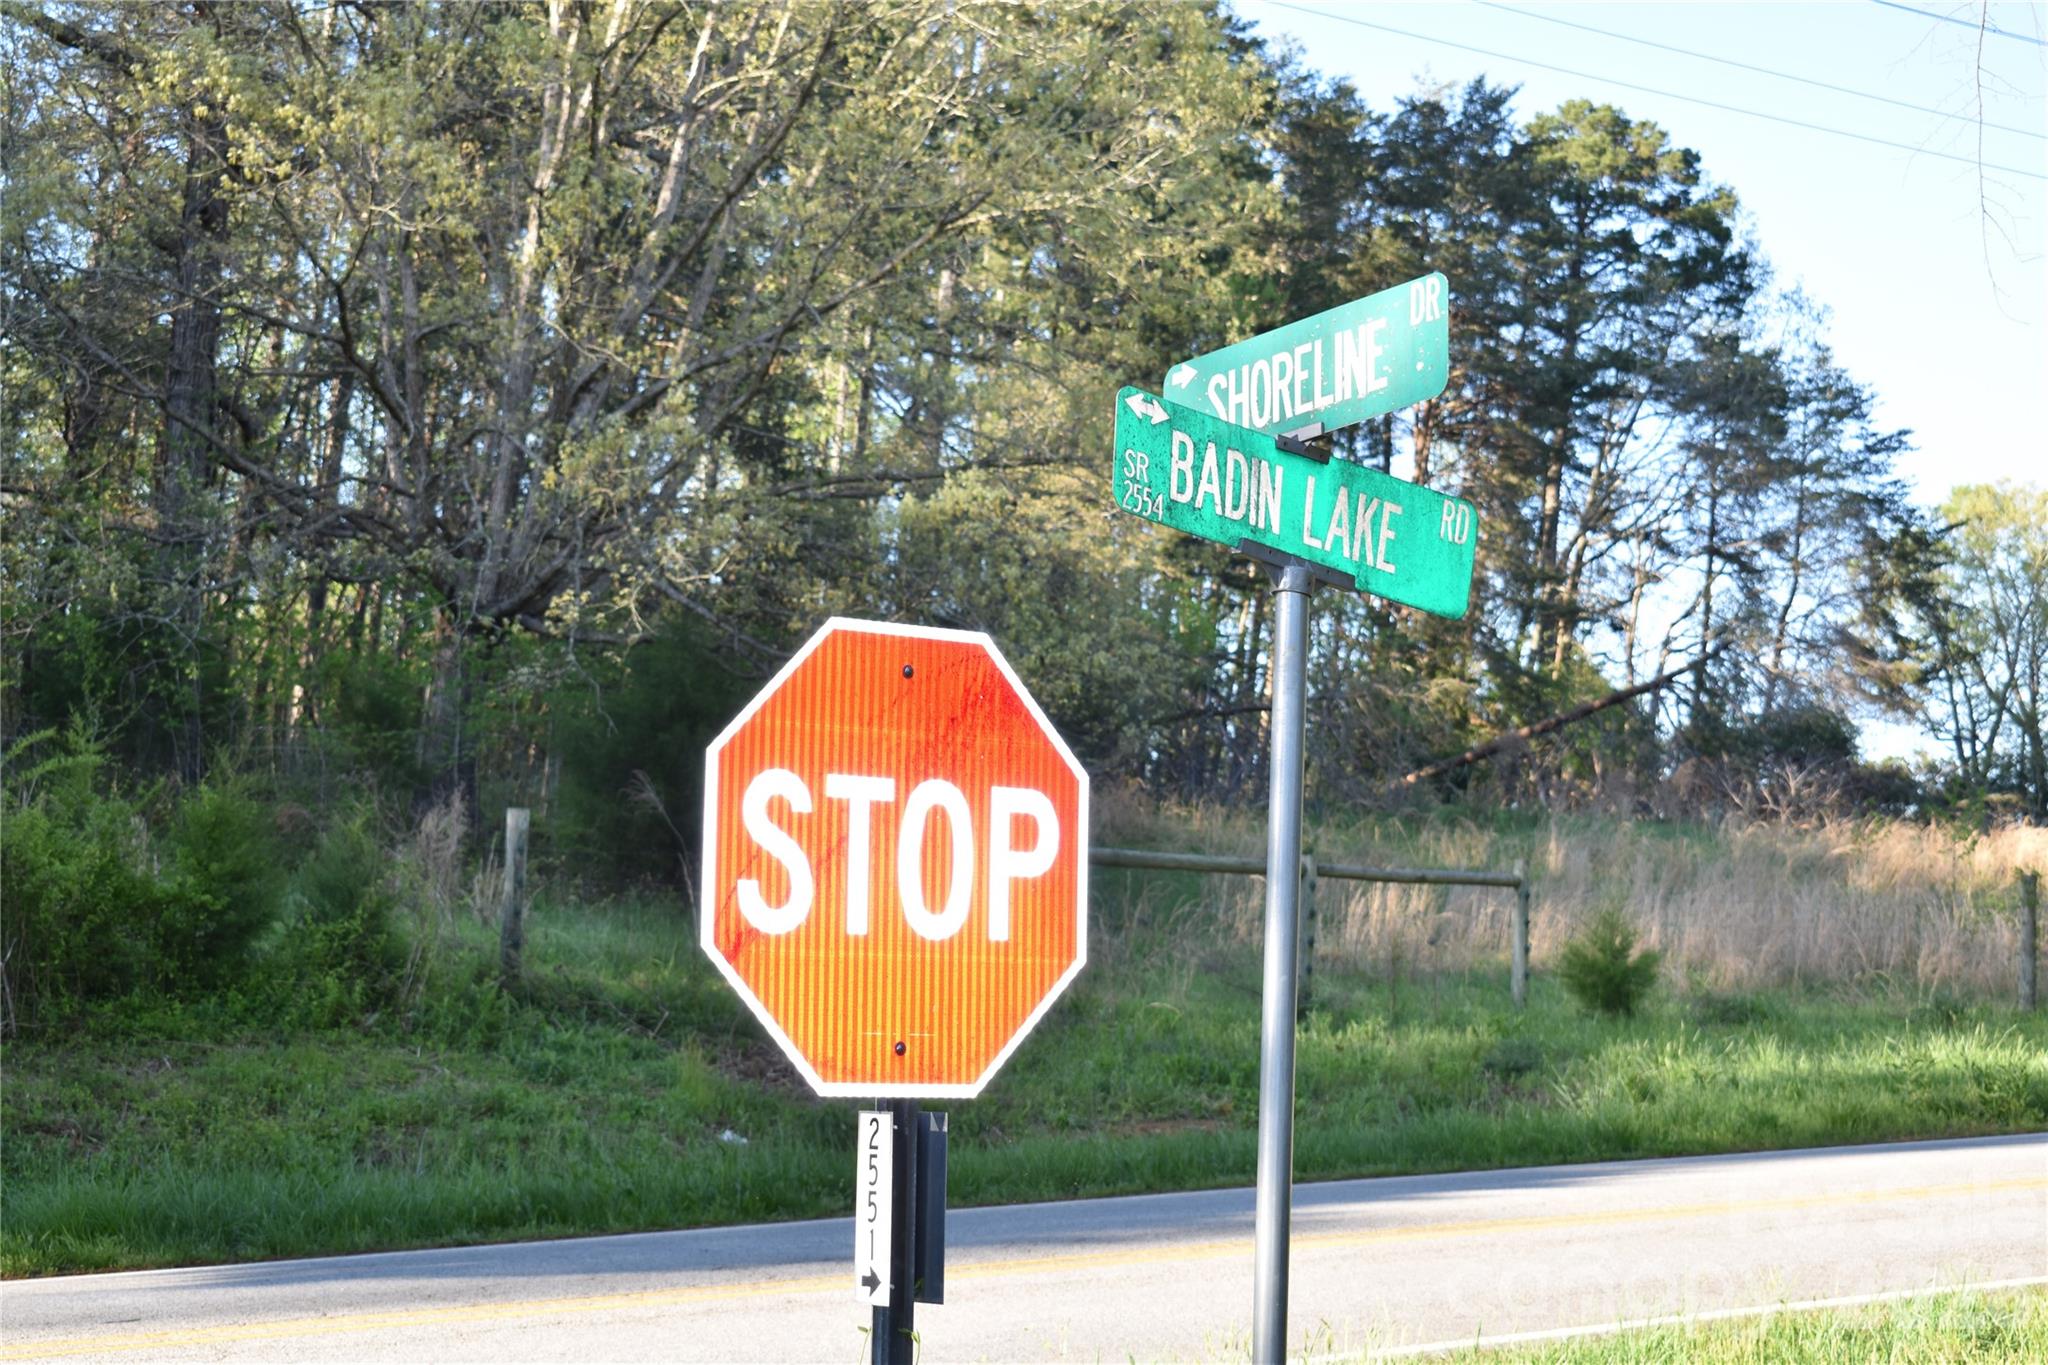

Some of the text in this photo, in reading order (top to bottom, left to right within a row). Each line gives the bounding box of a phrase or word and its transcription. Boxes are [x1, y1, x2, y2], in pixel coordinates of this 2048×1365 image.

[1208, 277, 1441, 428] SHORELINE DR
[1123, 480, 1163, 521] 2554
[1124, 449, 1148, 483] SR
[1169, 430, 1470, 574] BADIN LAKE RD
[737, 768, 1060, 942] STOP
[867, 1117, 880, 1261] 2551
